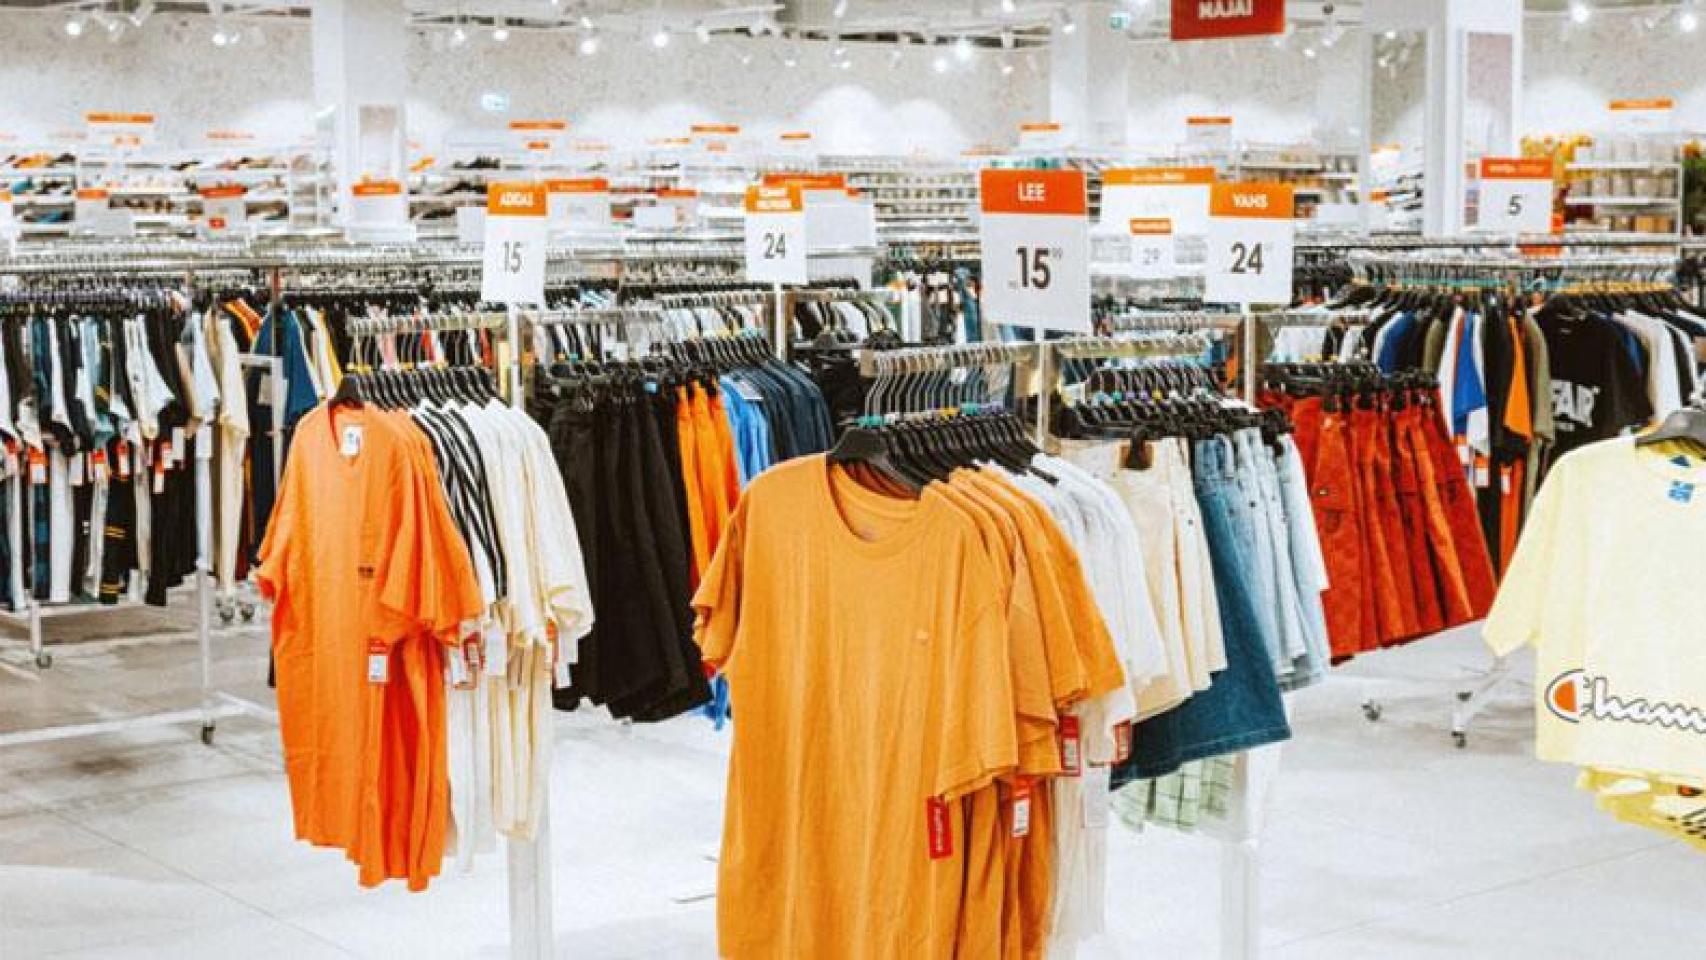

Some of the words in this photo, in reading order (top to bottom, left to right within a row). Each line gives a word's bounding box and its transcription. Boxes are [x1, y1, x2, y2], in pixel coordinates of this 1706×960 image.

[1017, 181, 1045, 201] LEE
[1509, 193, 1522, 216] 5
[504, 241, 522, 273] 15
[763, 232, 785, 259] 24
[1230, 242, 1263, 274] 24
[1015, 247, 1051, 290] 15
